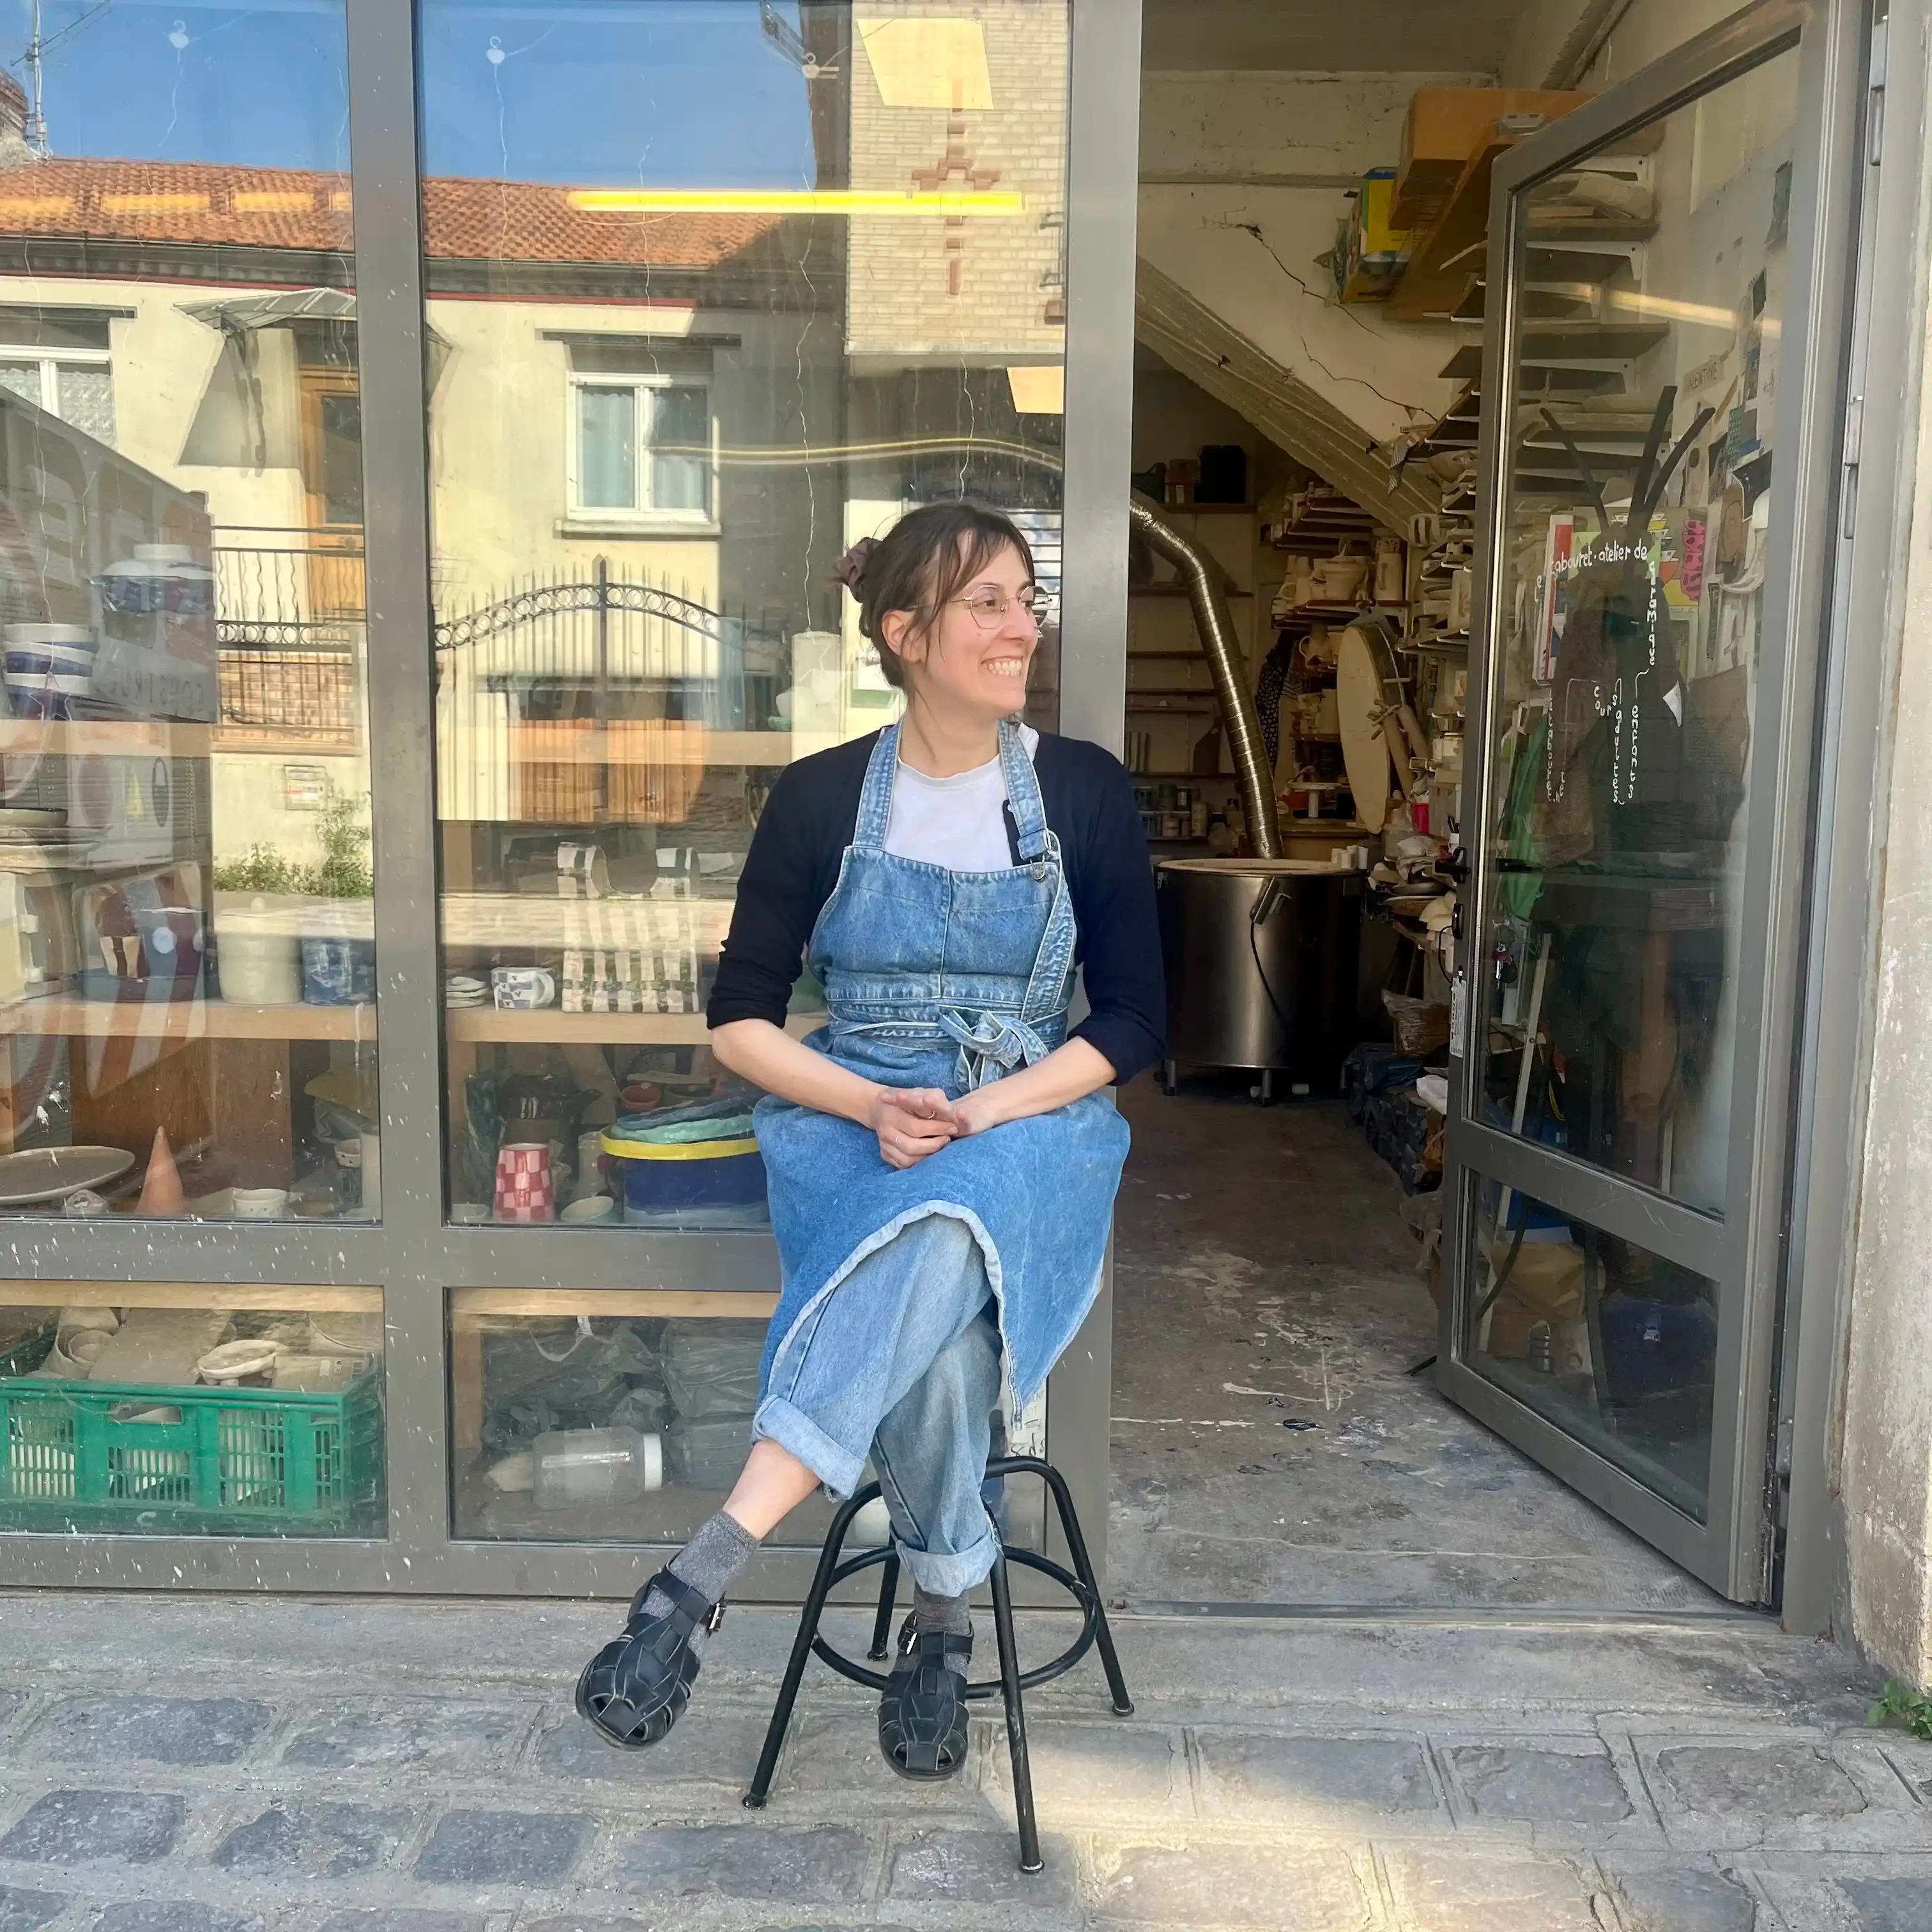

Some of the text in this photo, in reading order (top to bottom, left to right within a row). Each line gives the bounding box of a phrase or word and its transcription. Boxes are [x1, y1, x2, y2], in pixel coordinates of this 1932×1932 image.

[1598, 539, 1631, 563] atelier
[1634, 537, 1648, 560] de
[1593, 686, 1618, 717] cours
[1613, 710, 1622, 803] adultes
[1628, 705, 1639, 799] enfants
